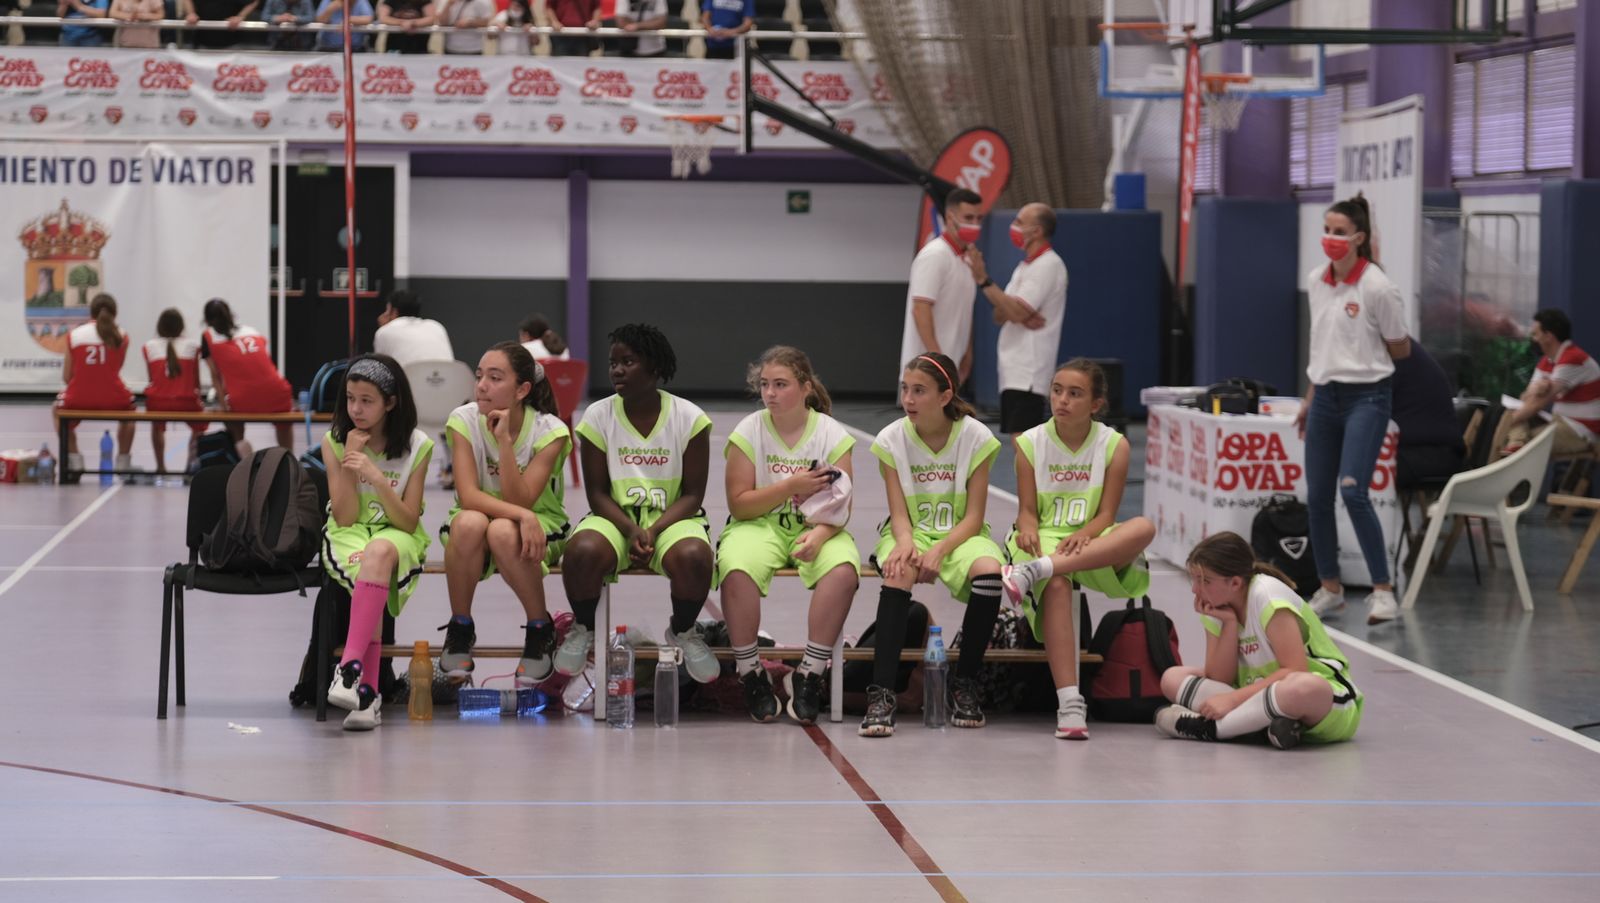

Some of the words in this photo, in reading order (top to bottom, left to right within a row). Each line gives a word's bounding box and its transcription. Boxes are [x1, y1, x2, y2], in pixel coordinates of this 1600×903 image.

[109, 158, 141, 184] DE
[152, 158, 254, 184] VIATOR
[85, 346, 106, 365] 21
[236, 338, 260, 353] 12
[624, 455, 668, 466] COVAP
[1055, 470, 1090, 482] COVA
[1215, 463, 1302, 491] OVAP
[918, 502, 953, 532] 20
[1053, 497, 1086, 527] 10
